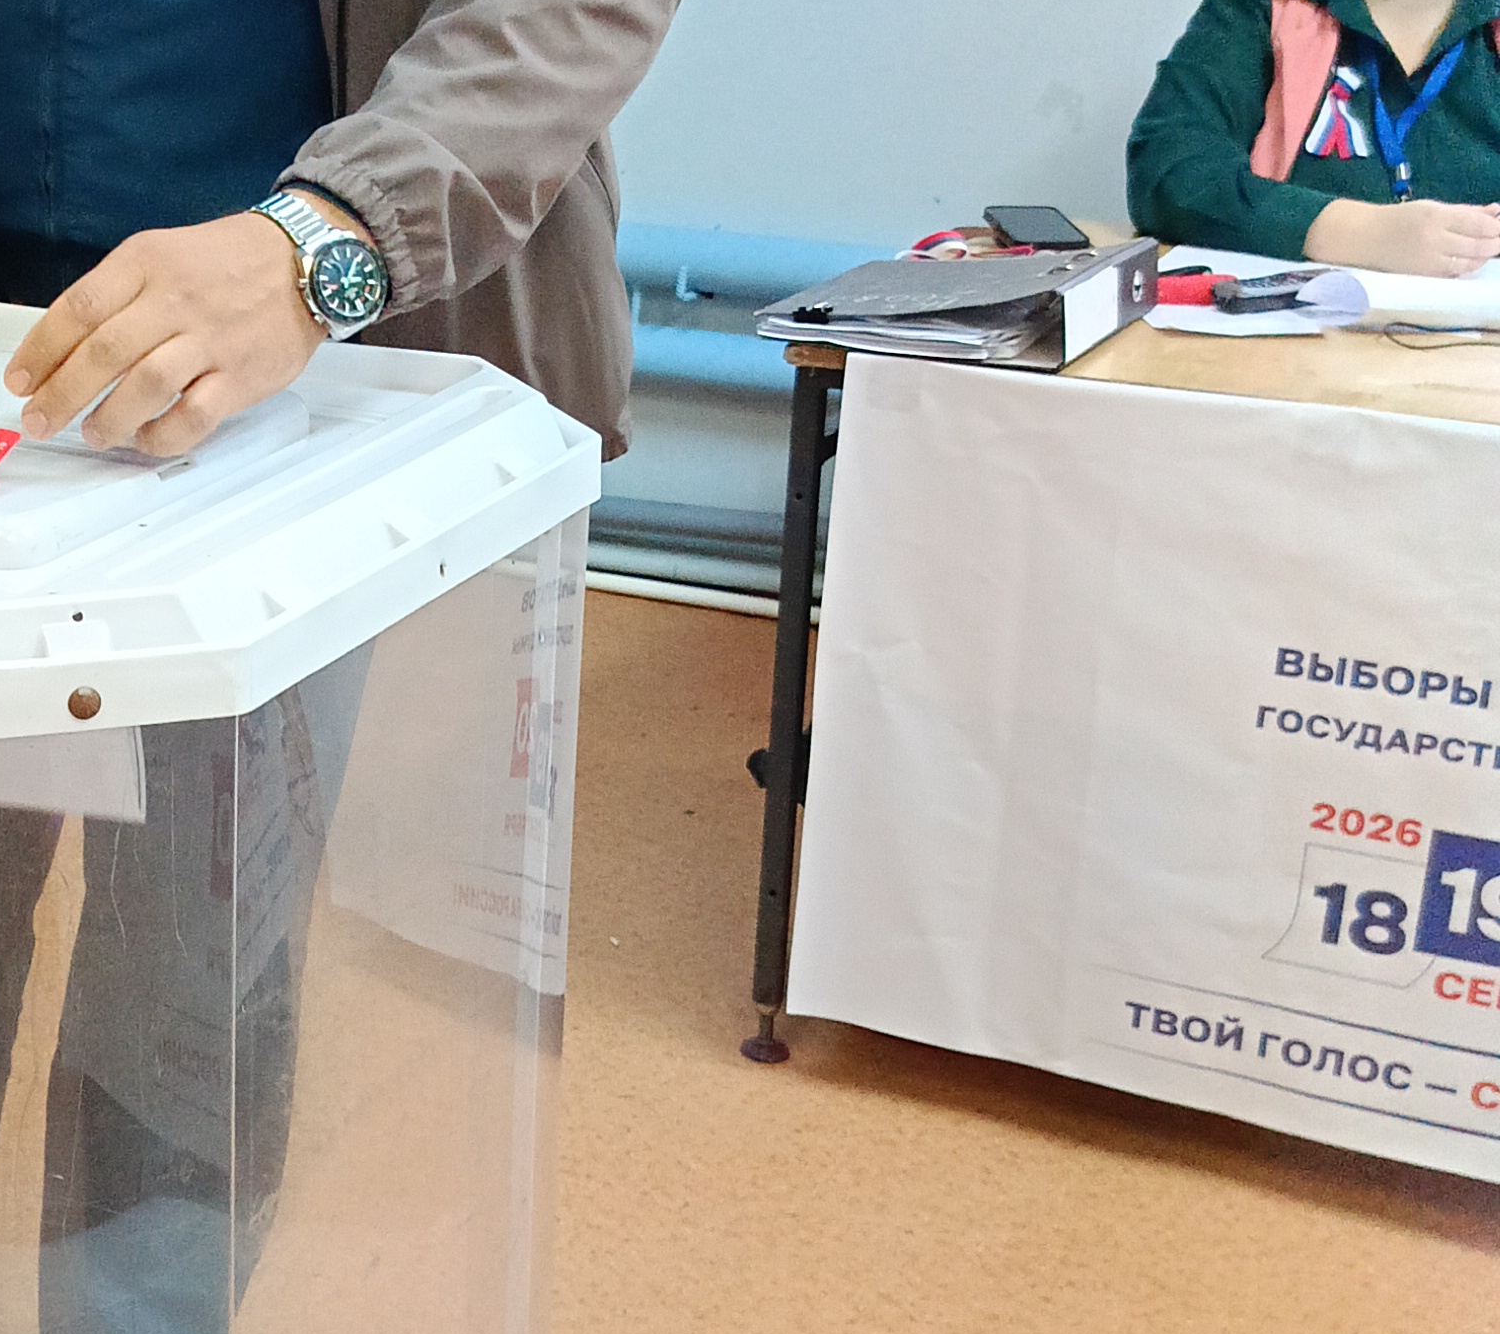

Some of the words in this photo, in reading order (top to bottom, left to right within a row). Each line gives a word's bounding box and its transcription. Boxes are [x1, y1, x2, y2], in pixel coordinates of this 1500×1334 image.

[1274, 647, 1493, 709] ВЫБОРЫ
[1310, 803, 1423, 848] 2026
[1313, 882, 1408, 957] 18
[1125, 1001, 1245, 1052] ТВОЙ
[1257, 1031, 1412, 1091] ГОЛОС
